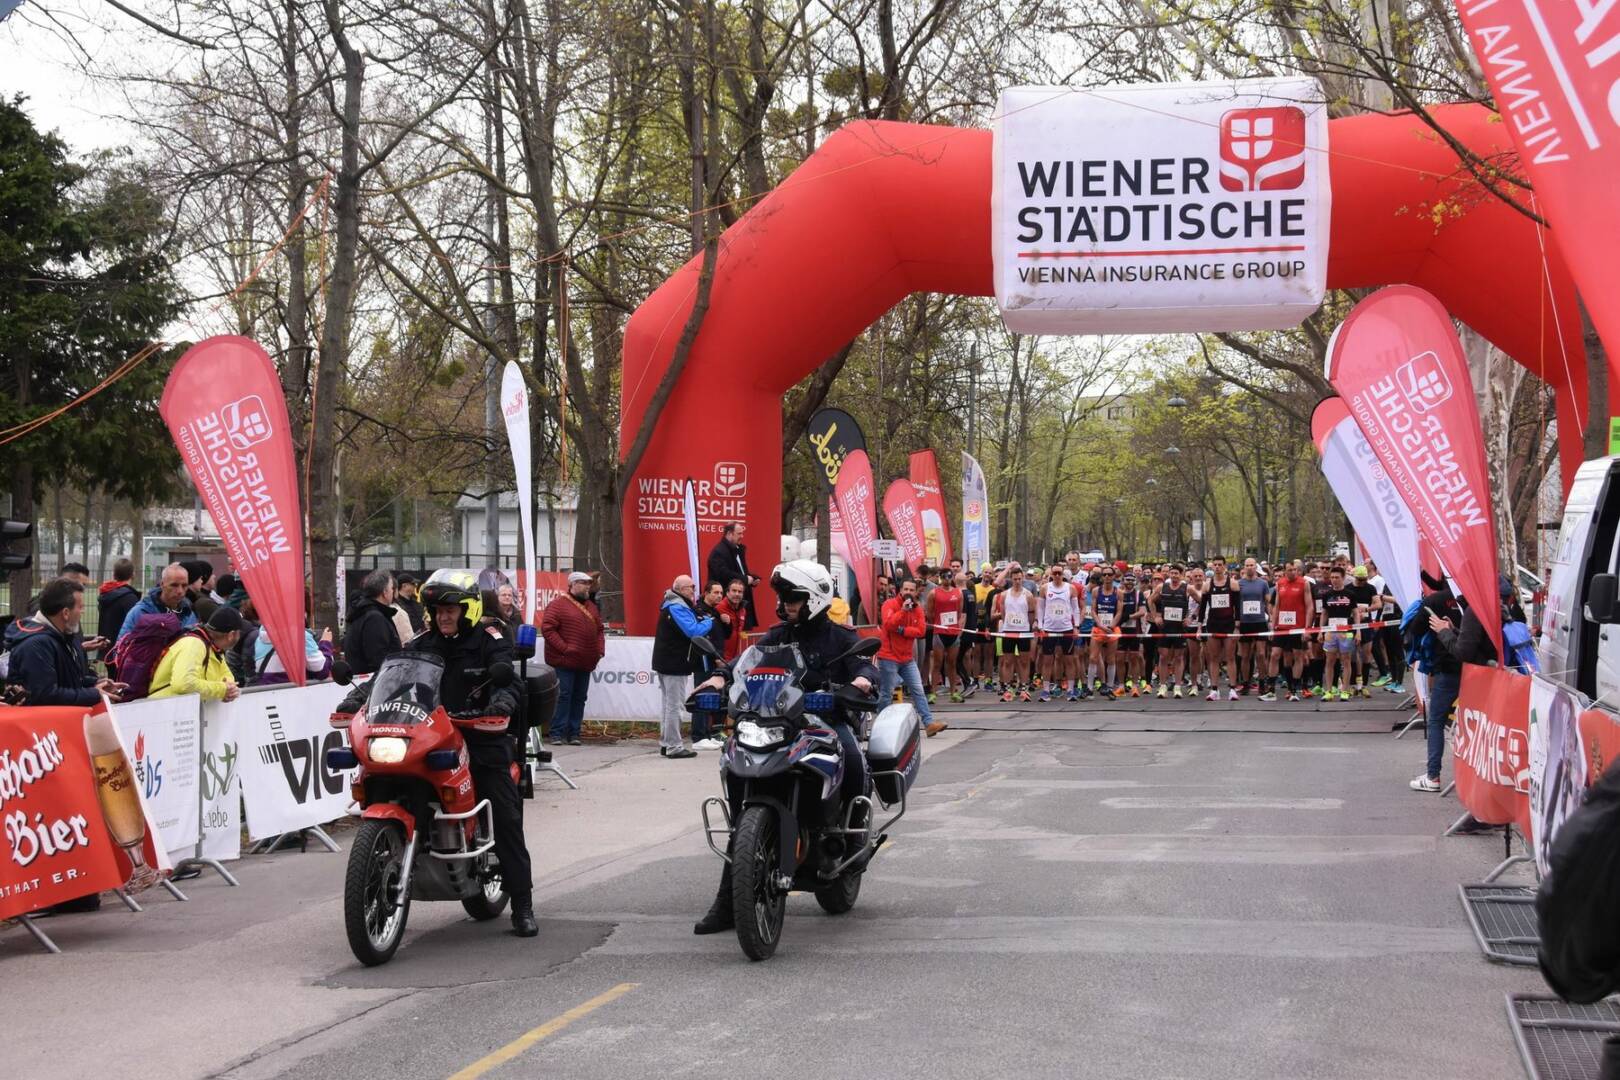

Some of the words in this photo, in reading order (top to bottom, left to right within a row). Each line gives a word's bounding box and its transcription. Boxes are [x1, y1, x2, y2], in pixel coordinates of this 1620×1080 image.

[1017, 157, 1210, 198] WIENER
[1016, 198, 1305, 243] STÄDTISCHE
[1018, 266, 1096, 283] VIENNA
[1103, 263, 1225, 282] INSURANCE
[1232, 260, 1305, 279] GROUP
[638, 497, 746, 517] STÄDTSCHE
[639, 521, 665, 530] VIENNA
[666, 523, 717, 533] INSUNCE
[747, 674, 784, 682] POLIZEI
[371, 726, 406, 734] HONDA
[5, 810, 88, 866] Bier
[15, 878, 40, 894] HAT
[52, 869, 86, 885] ER.
